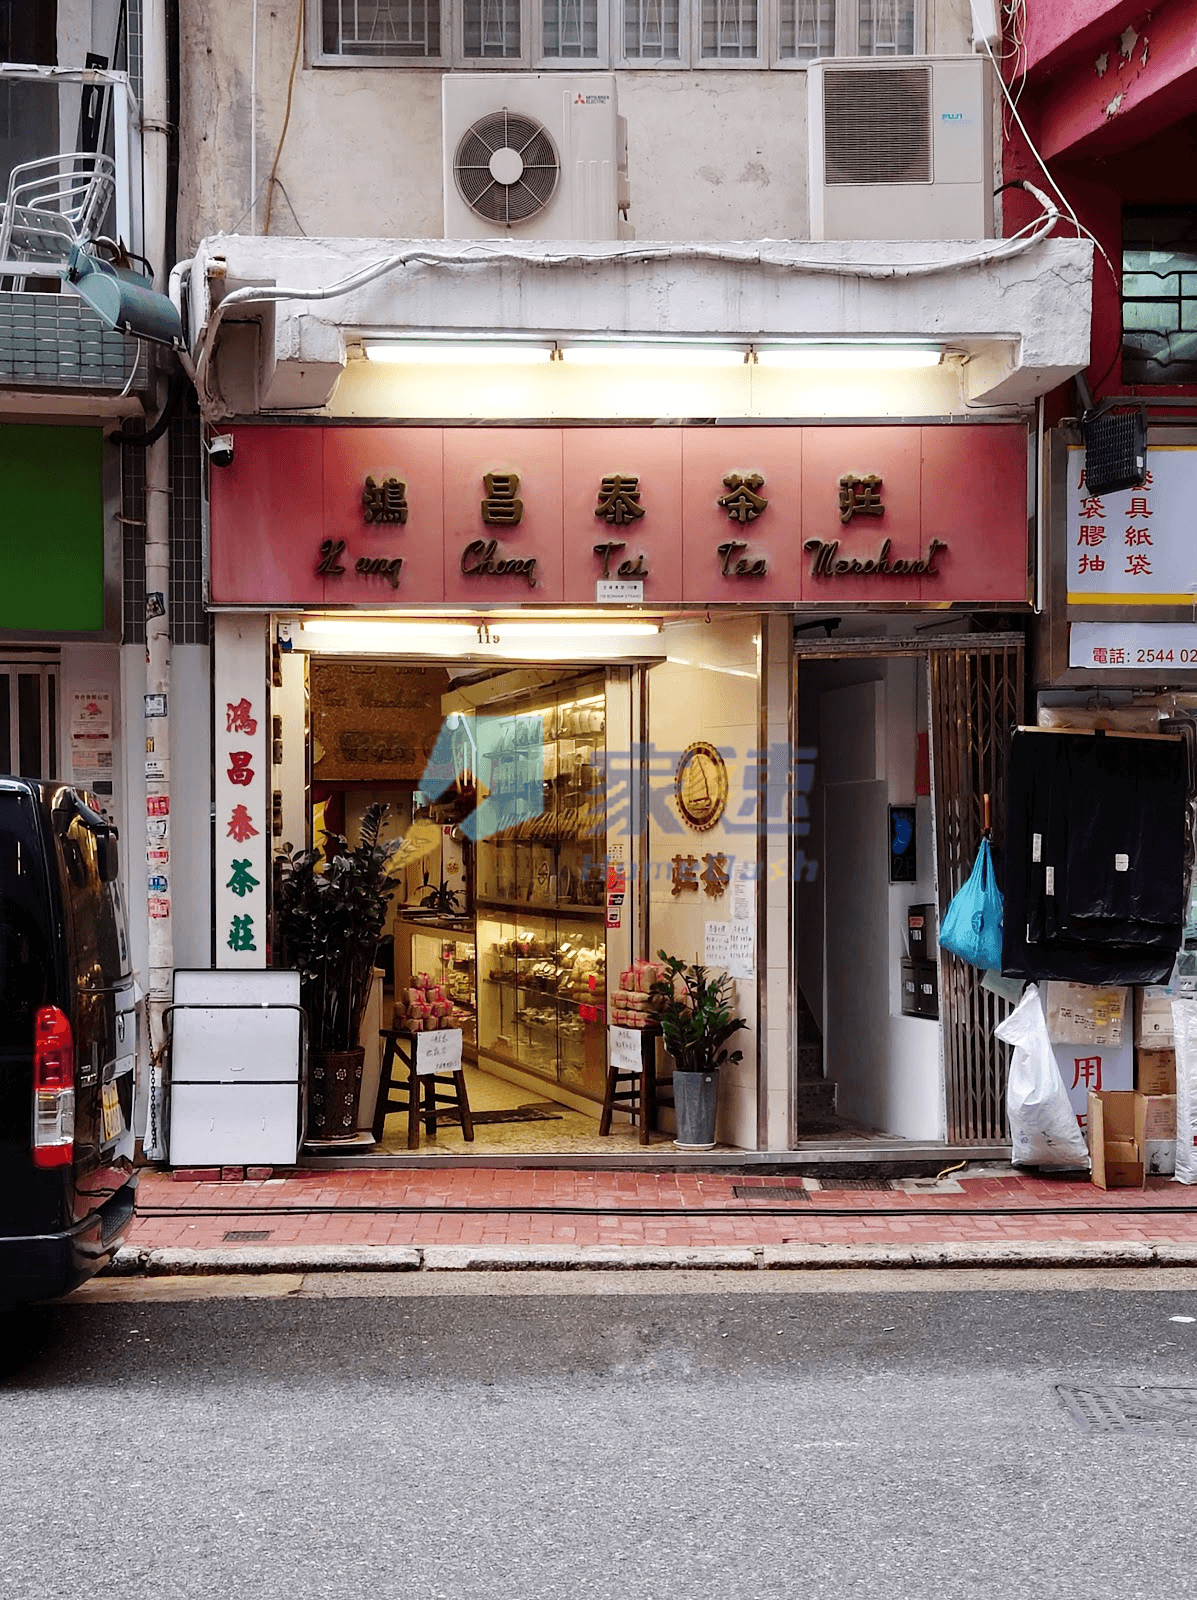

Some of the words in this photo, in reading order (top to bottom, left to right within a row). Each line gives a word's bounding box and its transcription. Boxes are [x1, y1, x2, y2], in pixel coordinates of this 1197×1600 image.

[593, 541, 649, 579] Tai
[717, 541, 767, 577] Tea
[804, 538, 947, 576] Merchant
[478, 634, 500, 644] 119
[1137, 649, 1174, 663] 2544
